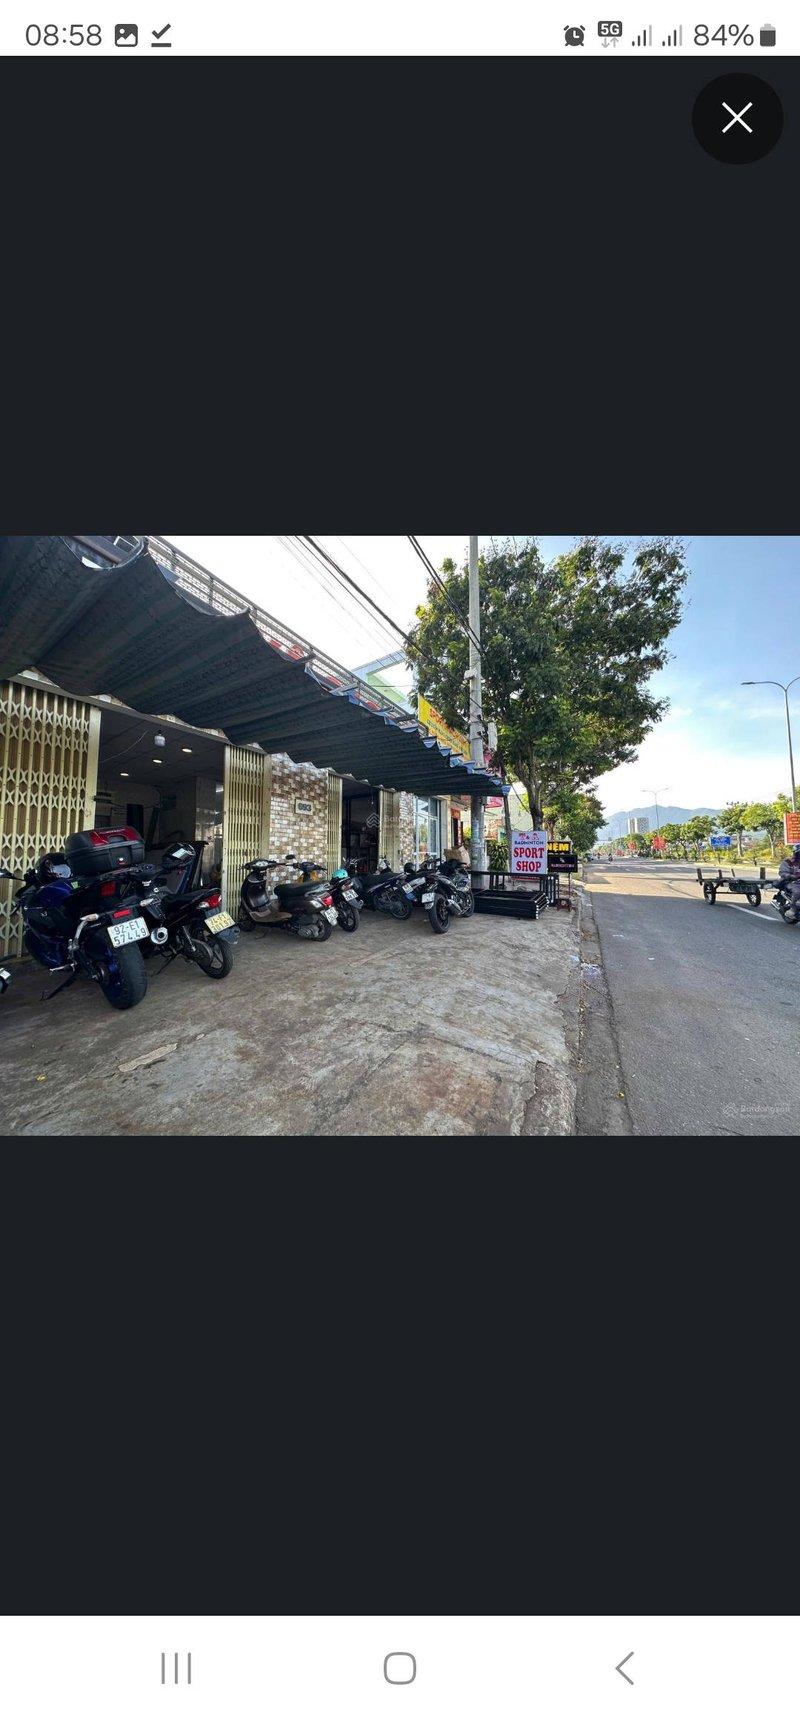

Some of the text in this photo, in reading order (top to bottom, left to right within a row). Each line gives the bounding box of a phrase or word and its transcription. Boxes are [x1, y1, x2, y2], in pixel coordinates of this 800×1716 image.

[513, 847, 544, 859] SPORT
[516, 860, 541, 873] SHOP
[113, 920, 140, 935] 92-E1
[113, 927, 147, 945] 574.49
